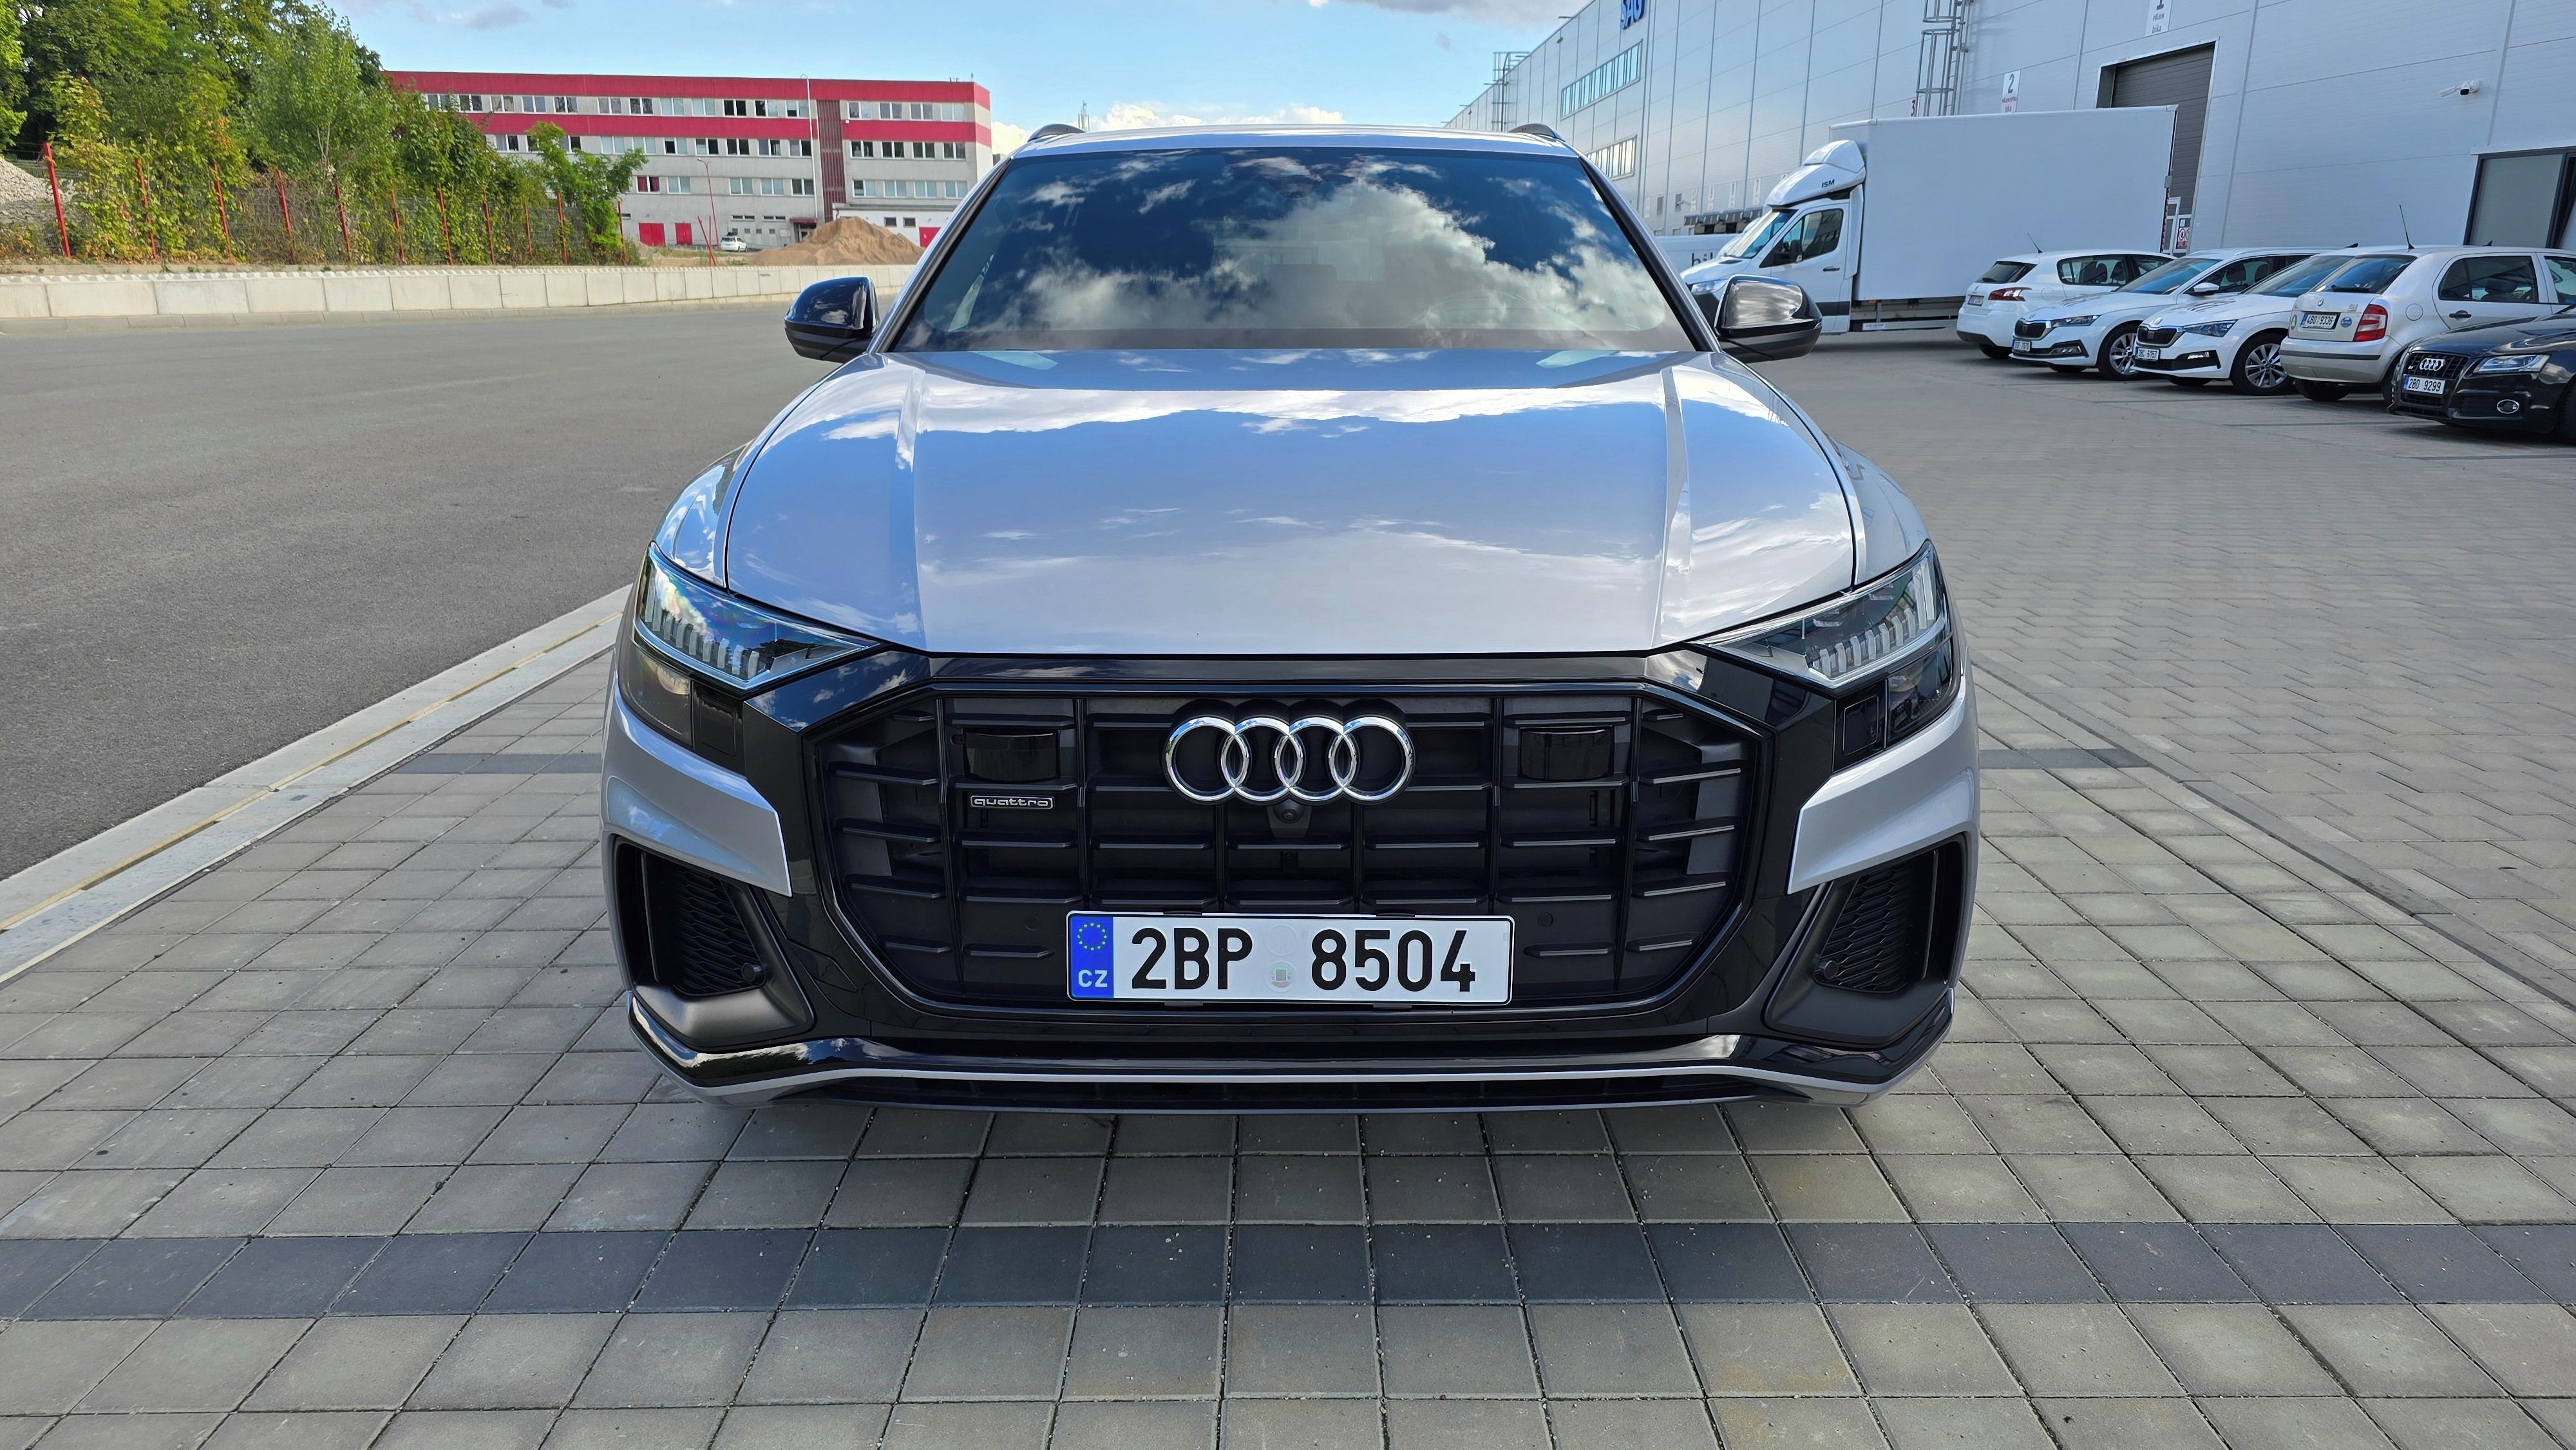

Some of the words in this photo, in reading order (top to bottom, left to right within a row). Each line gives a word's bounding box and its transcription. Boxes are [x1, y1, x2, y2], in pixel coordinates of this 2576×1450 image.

[2007, 73, 2014, 94] 2
[1821, 178, 1835, 189] ISM
[2423, 380, 2441, 392] 9299
[974, 798, 1048, 807] quattro
[1077, 968, 1108, 988] CZ
[1131, 927, 1253, 990] 2BP
[1311, 928, 1476, 993] 8504
